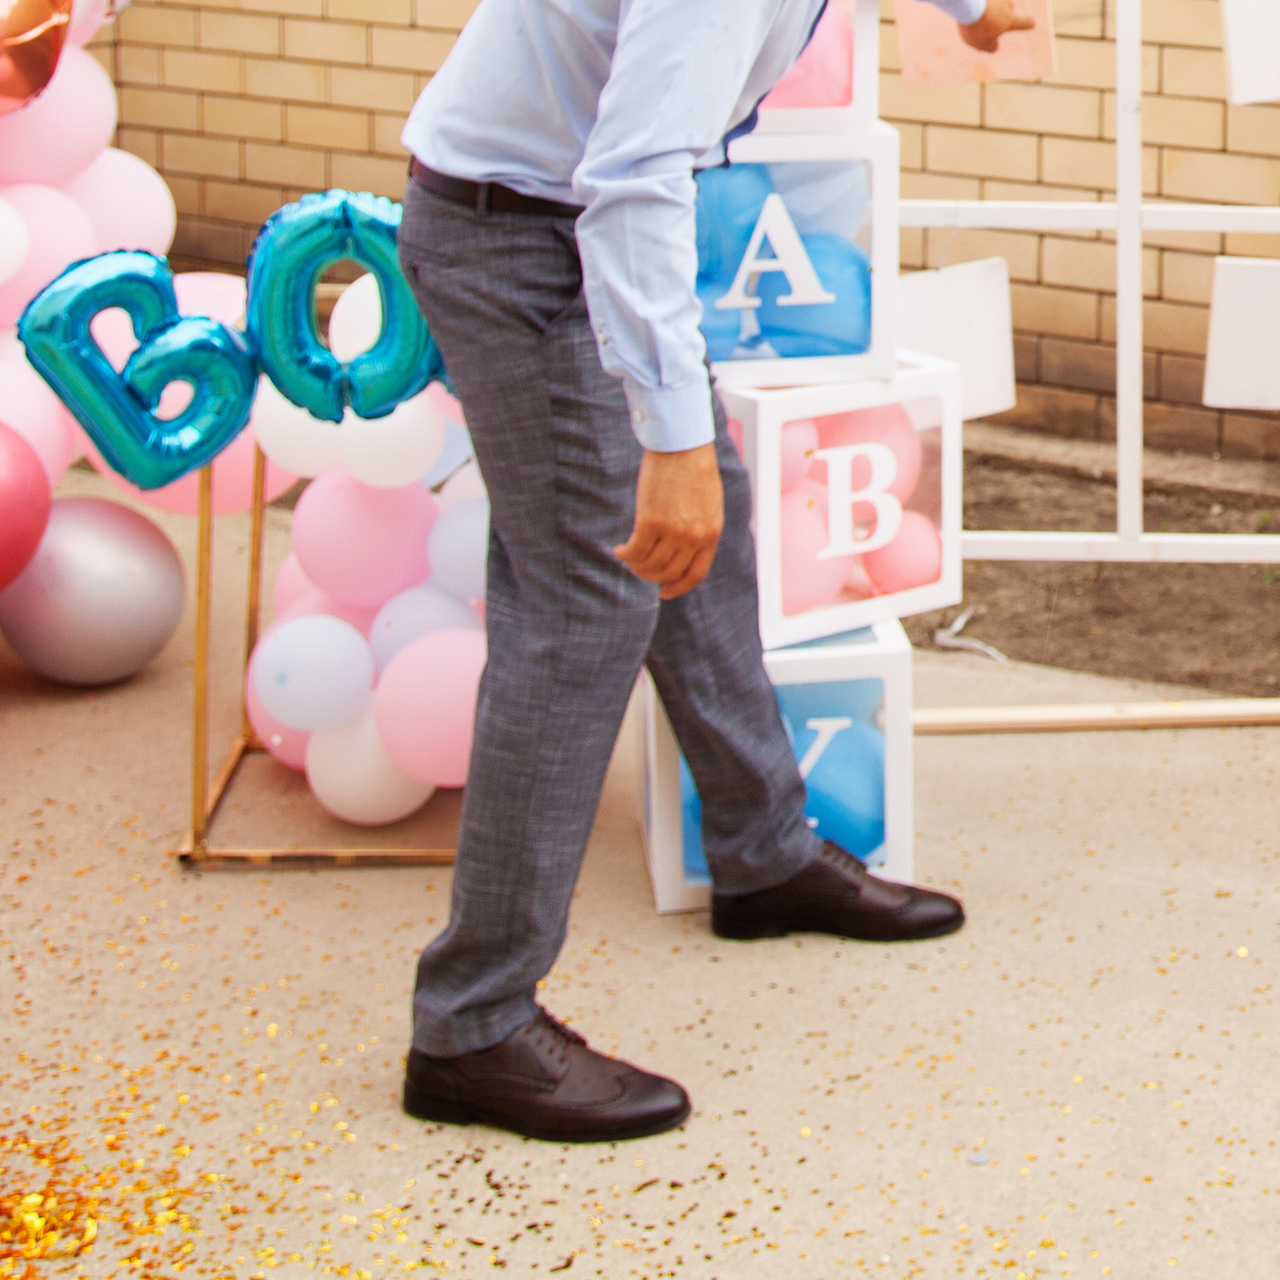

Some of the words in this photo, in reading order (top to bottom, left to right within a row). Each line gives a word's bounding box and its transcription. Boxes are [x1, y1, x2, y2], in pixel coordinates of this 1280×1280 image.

[714, 192, 837, 310] A
[18, 189, 460, 489] BO
[814, 442, 903, 560] B
